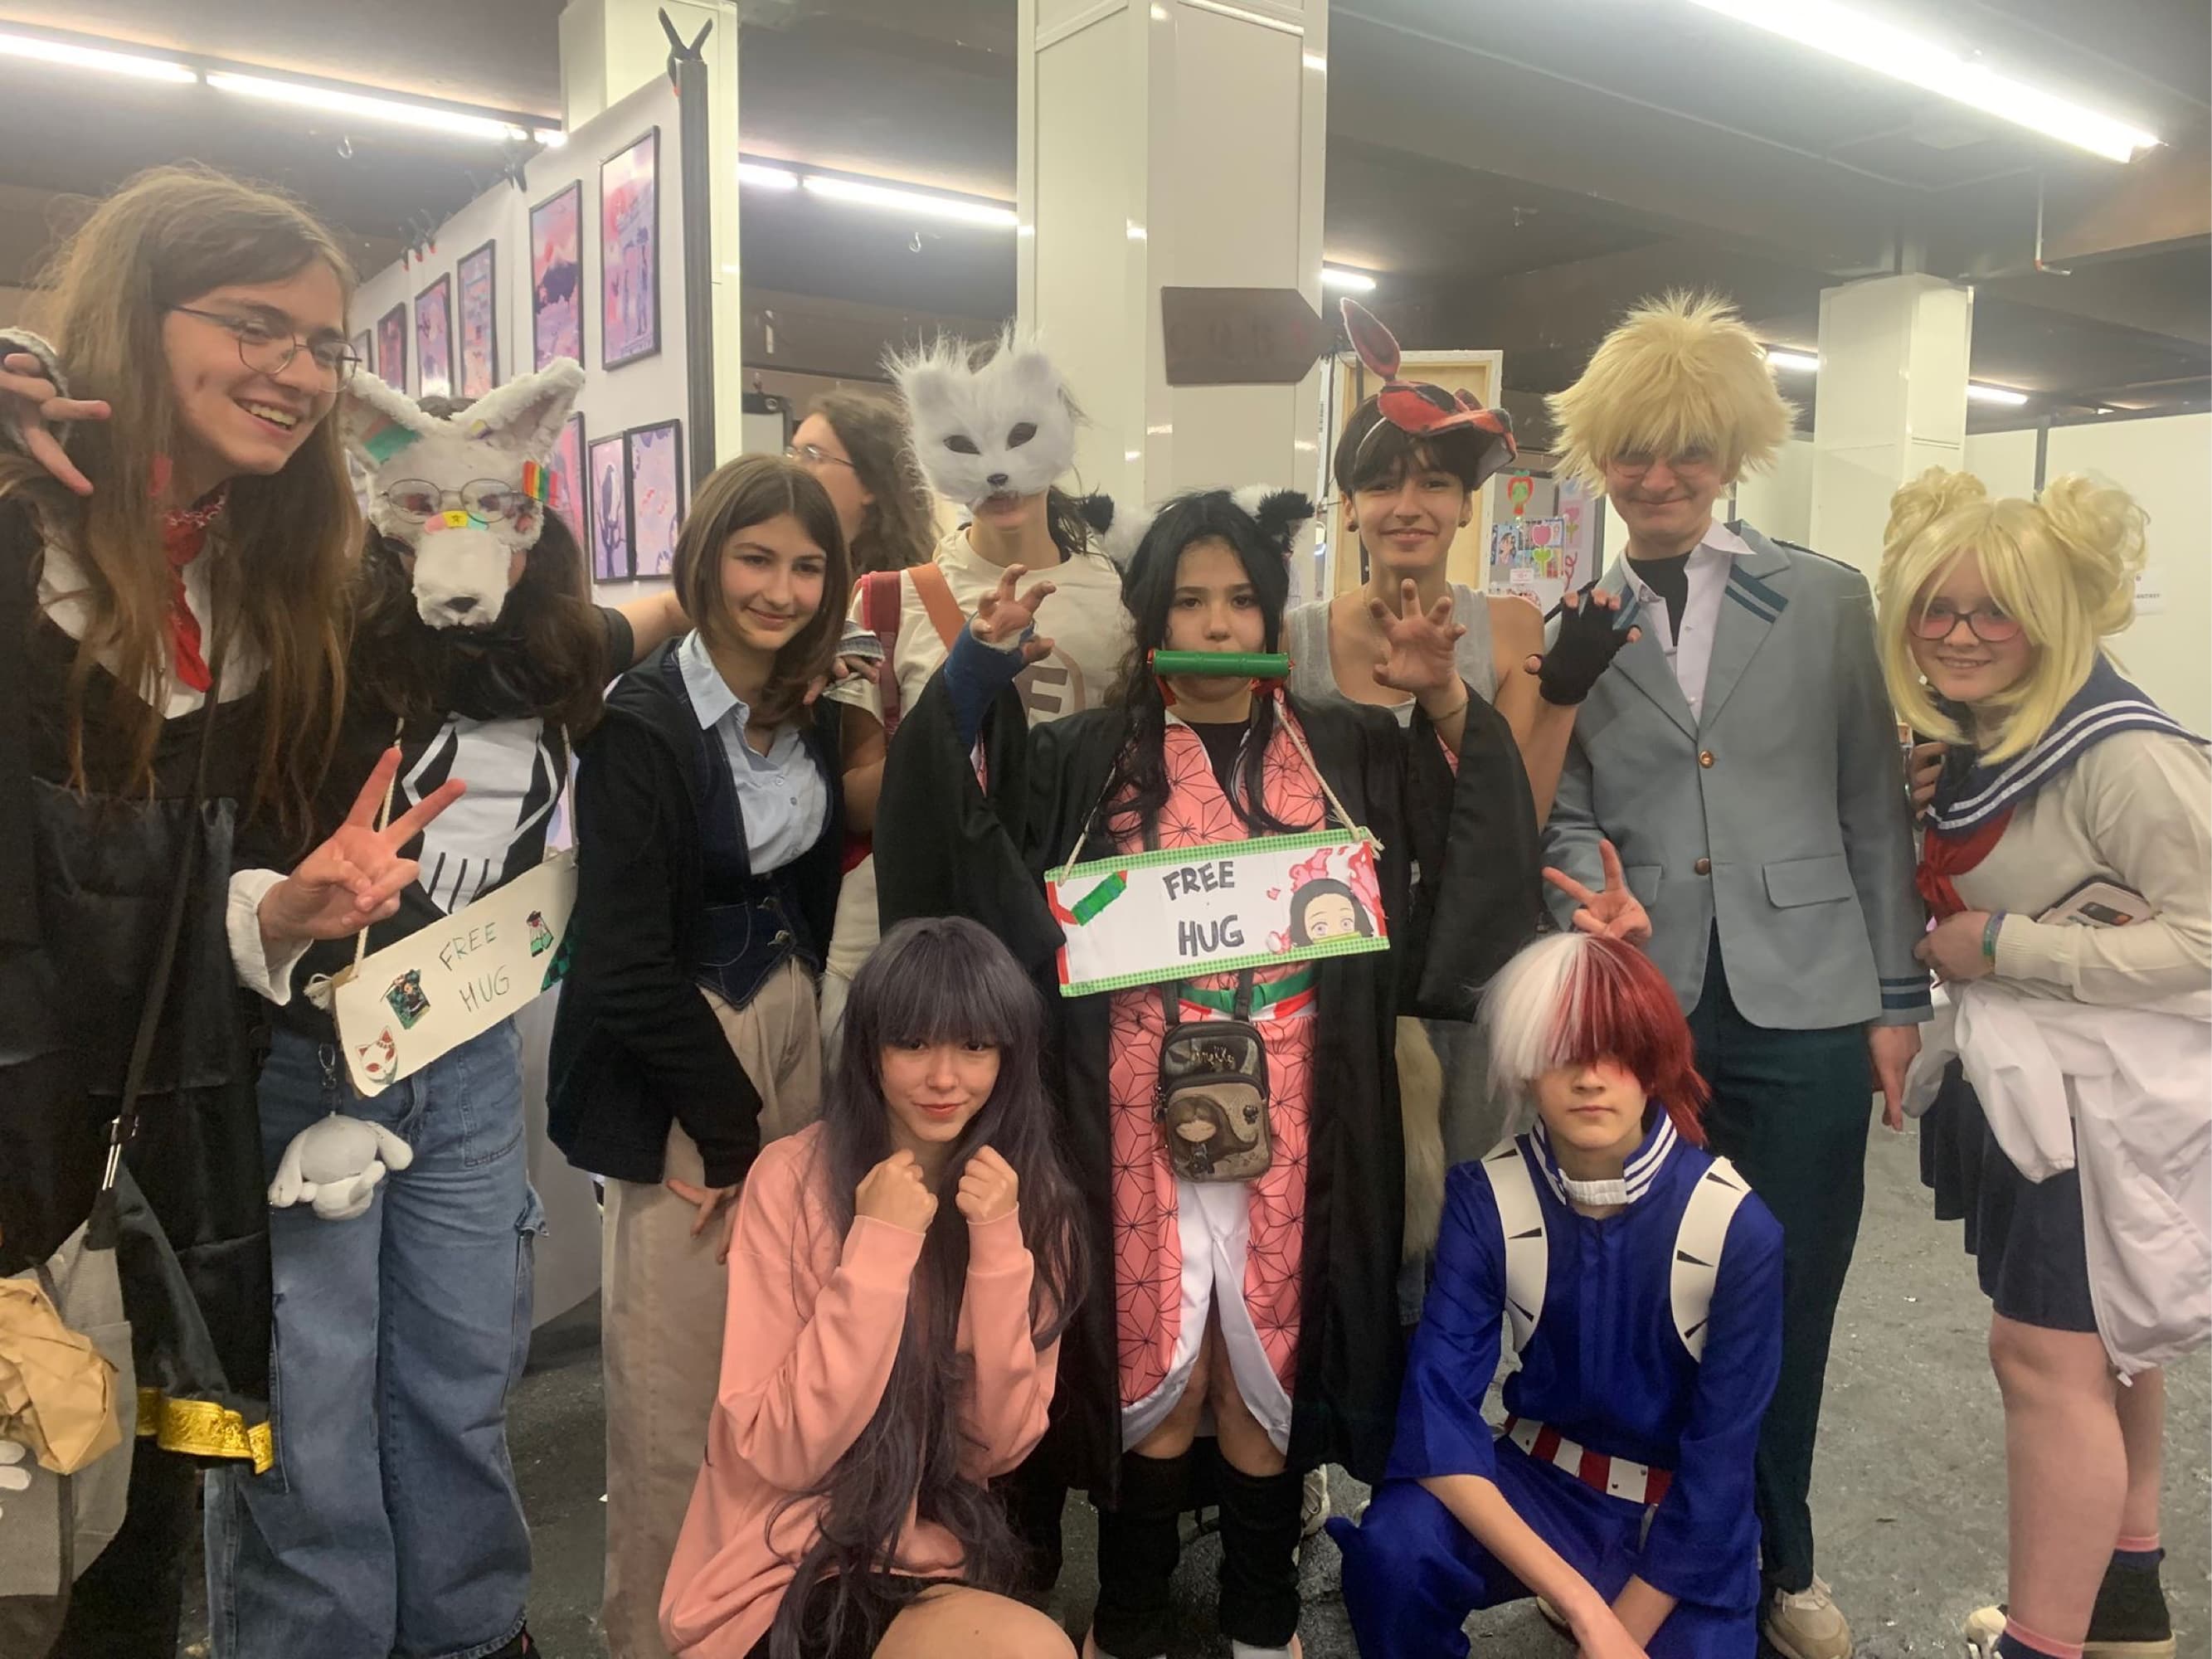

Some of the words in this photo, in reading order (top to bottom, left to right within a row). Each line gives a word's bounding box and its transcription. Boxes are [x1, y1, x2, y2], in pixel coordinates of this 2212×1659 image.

[1162, 860, 1236, 902] FREE
[439, 922, 498, 972] FREE
[1178, 914, 1245, 957] HUG
[459, 964, 511, 1014] HUG
